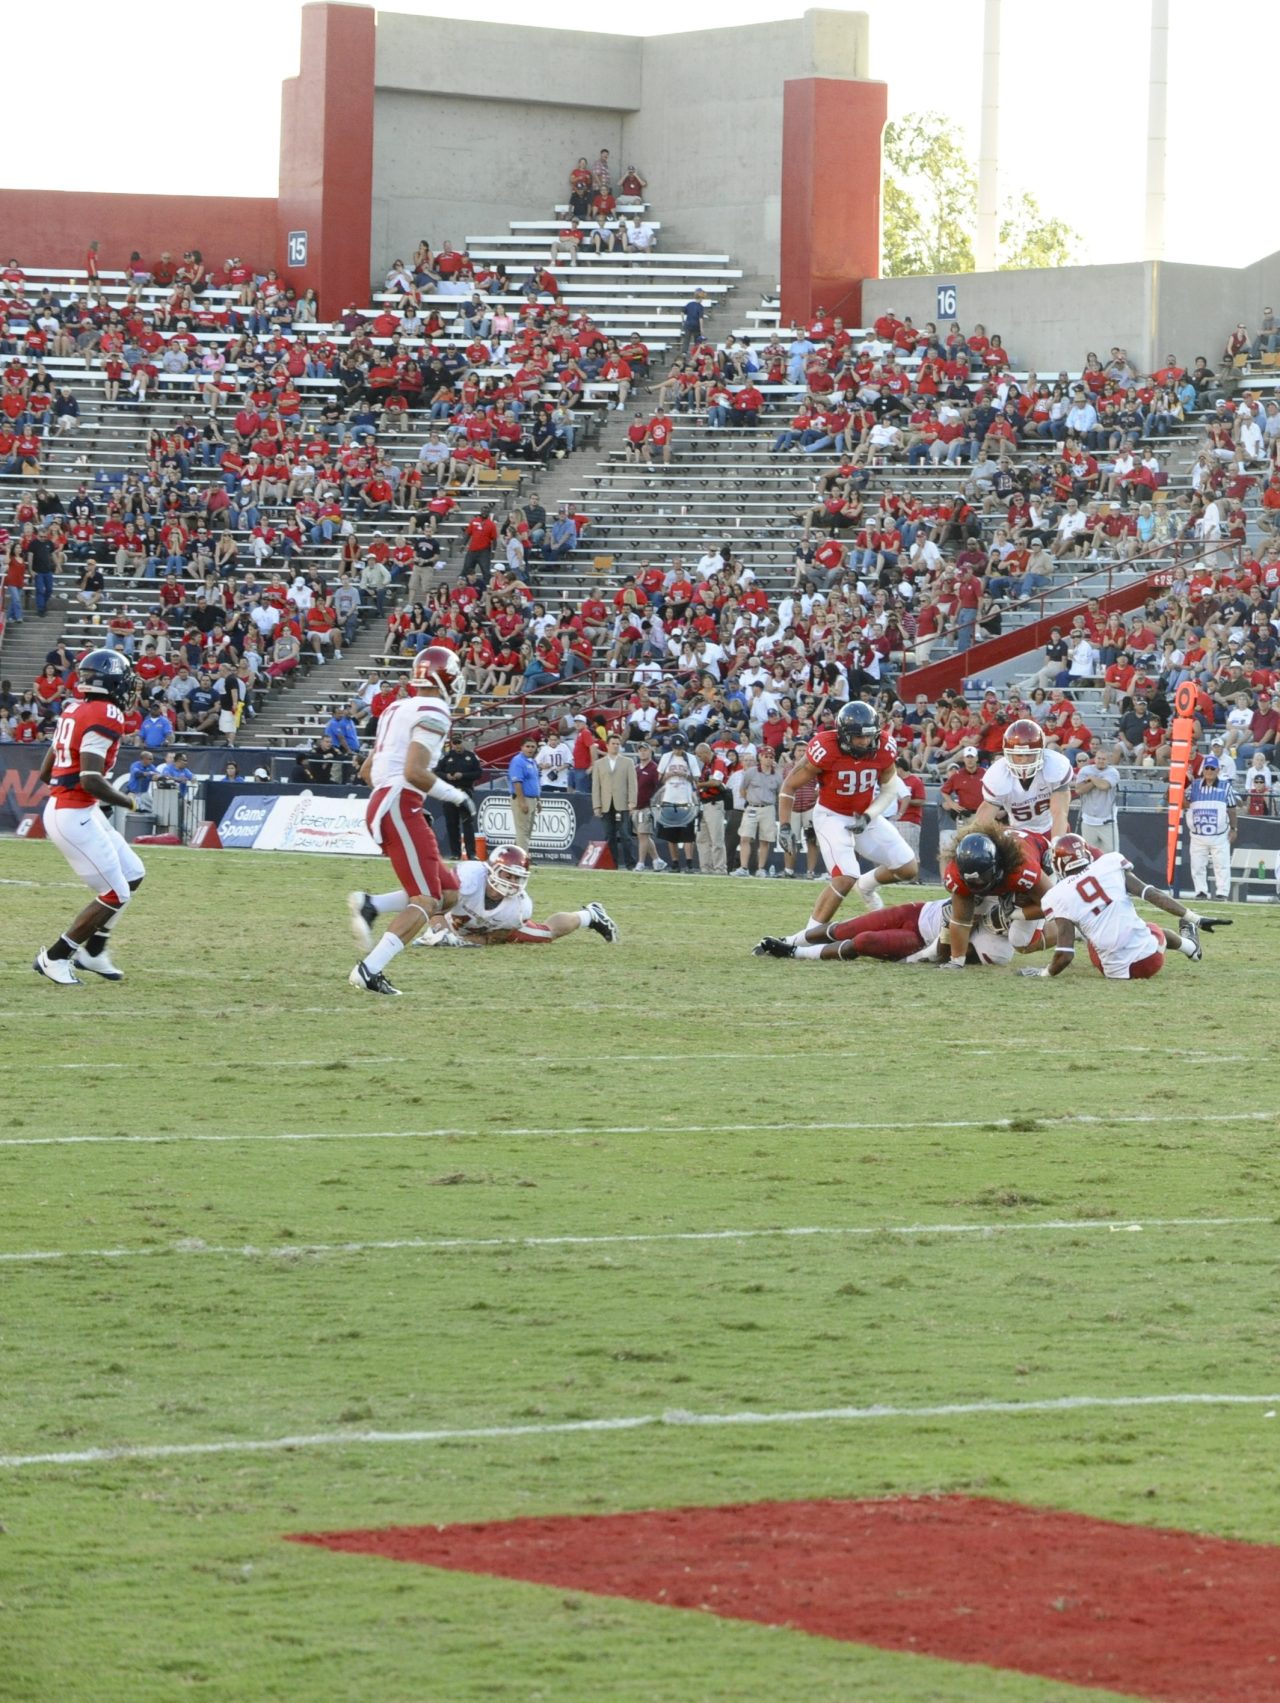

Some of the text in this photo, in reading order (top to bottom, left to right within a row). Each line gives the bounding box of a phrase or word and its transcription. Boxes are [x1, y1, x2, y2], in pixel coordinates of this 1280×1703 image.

[290, 237, 306, 261] 15
[937, 289, 956, 315] 16
[807, 740, 827, 763] 38
[836, 768, 877, 796] 38
[234, 805, 266, 821] Game
[487, 812, 510, 831] SOL
[1193, 816, 1217, 824] PAC
[17, 818, 32, 836] G
[1195, 825, 1217, 835] 10
[582, 845, 602, 867] 20
[1017, 869, 1038, 890] 31
[1075, 875, 1114, 917] 9
